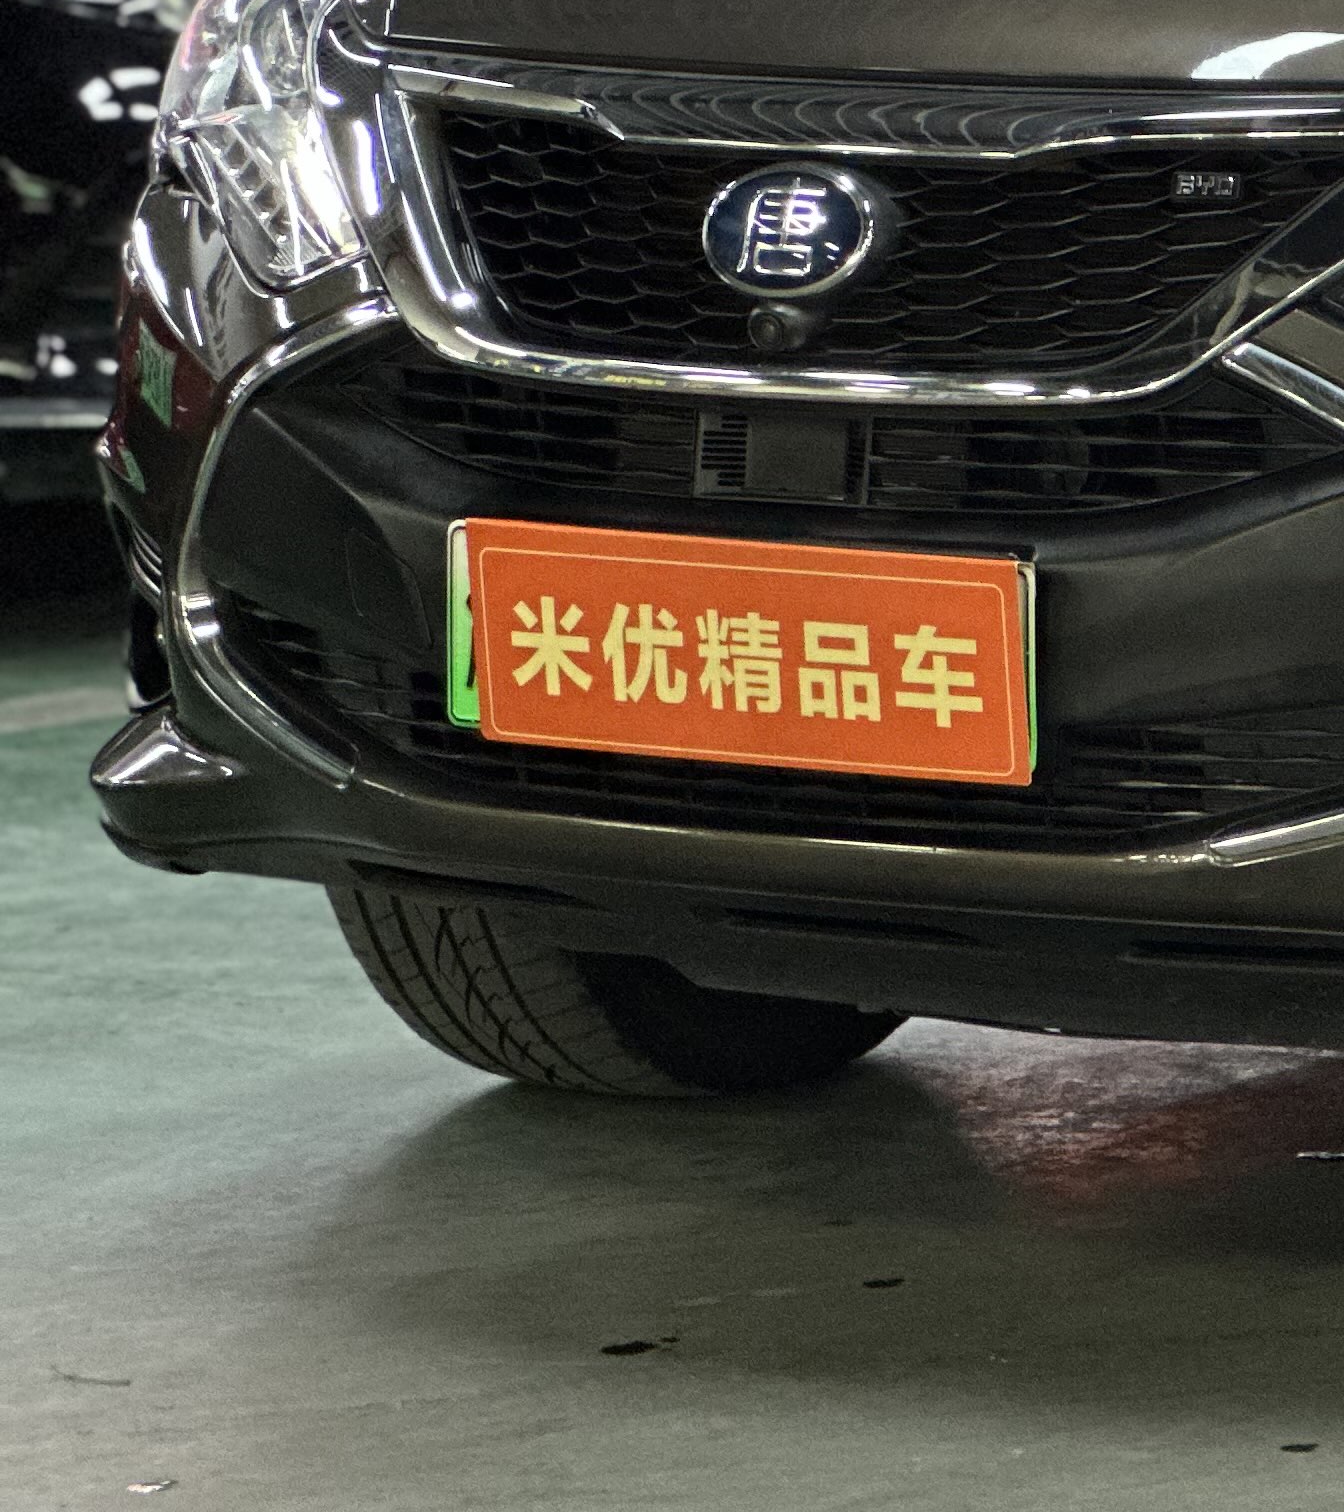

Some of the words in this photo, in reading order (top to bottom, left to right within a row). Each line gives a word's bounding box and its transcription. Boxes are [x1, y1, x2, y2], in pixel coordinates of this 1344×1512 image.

[510, 596, 984, 728] 米优精品车
